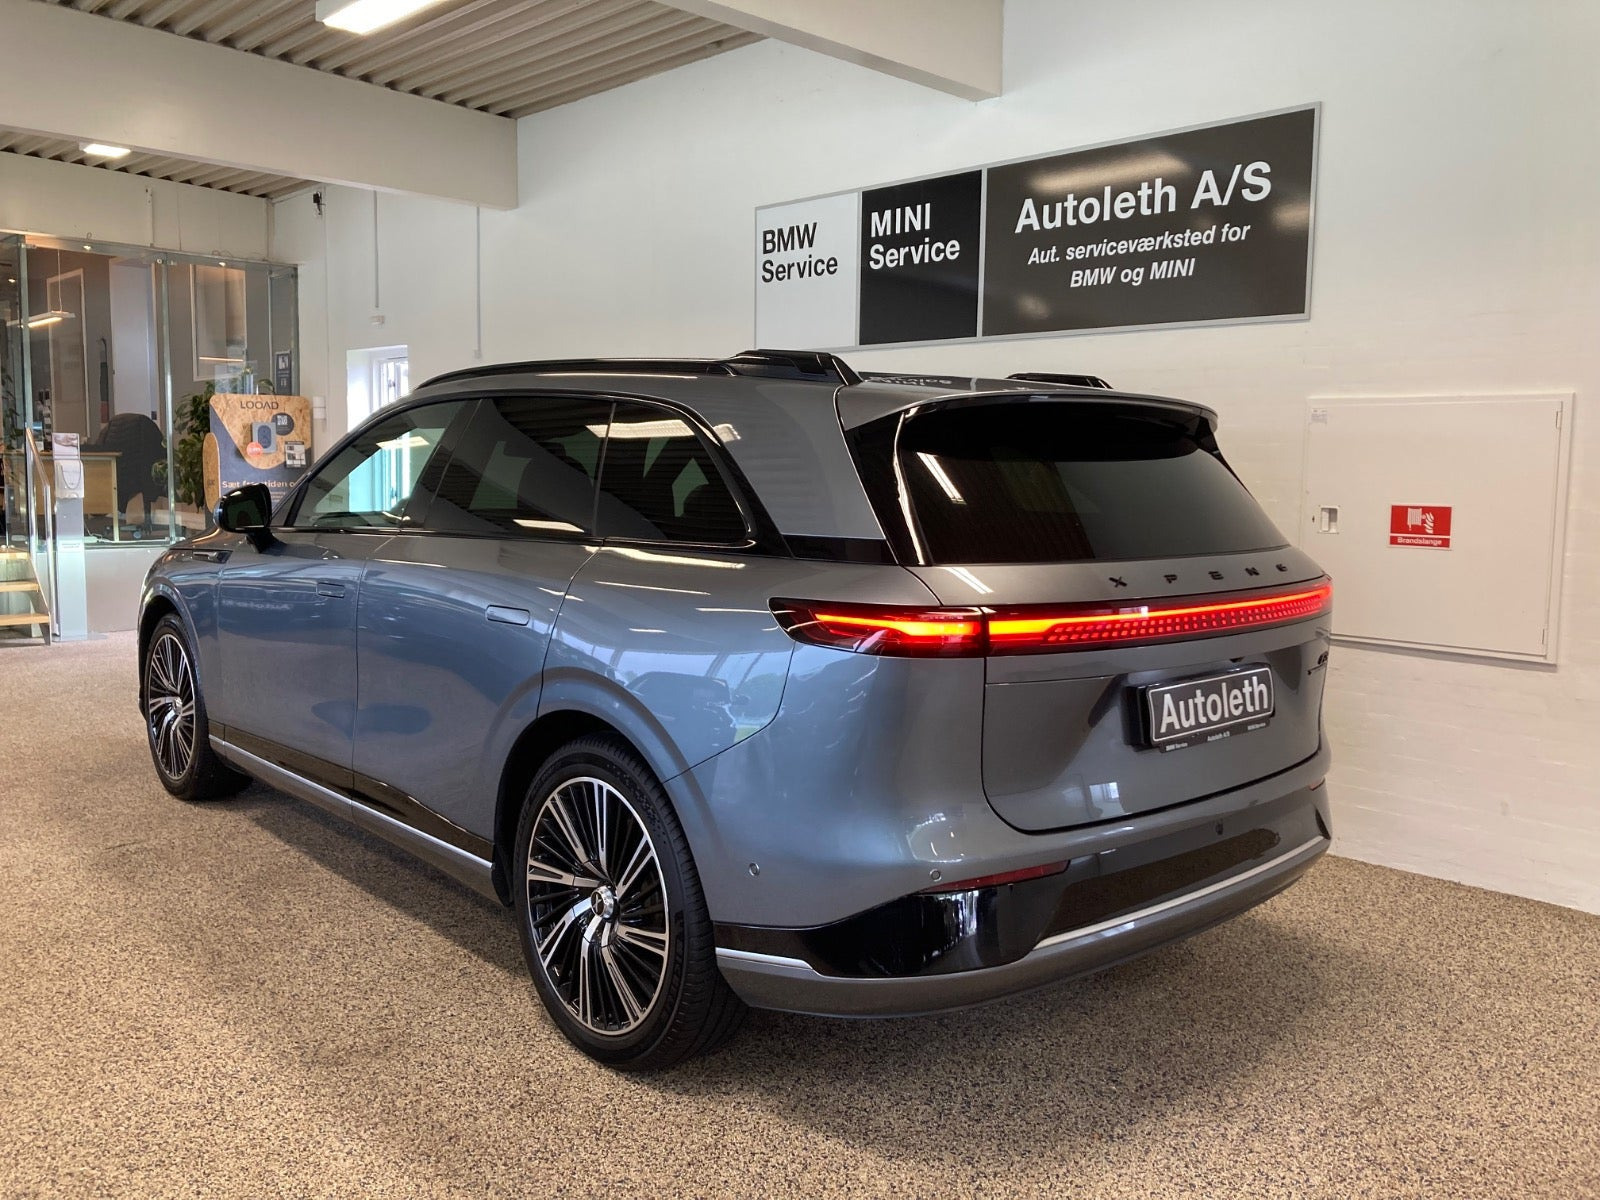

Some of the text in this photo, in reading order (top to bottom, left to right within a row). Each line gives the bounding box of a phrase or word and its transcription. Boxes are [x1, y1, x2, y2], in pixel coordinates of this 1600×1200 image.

[1014, 161, 1272, 235] Autoleth A/S
[870, 202, 932, 239] MINI
[761, 222, 818, 256] BMW
[869, 238, 962, 270] Service
[1027, 223, 1251, 266] Aut. serviceværksted for
[761, 256, 839, 283] Service
[1070, 257, 1196, 289] BMW og MINI
[242, 480, 287, 488] frtiden
[1397, 537, 1442, 546] Brandslange
[1160, 676, 1268, 733] Autoleth
